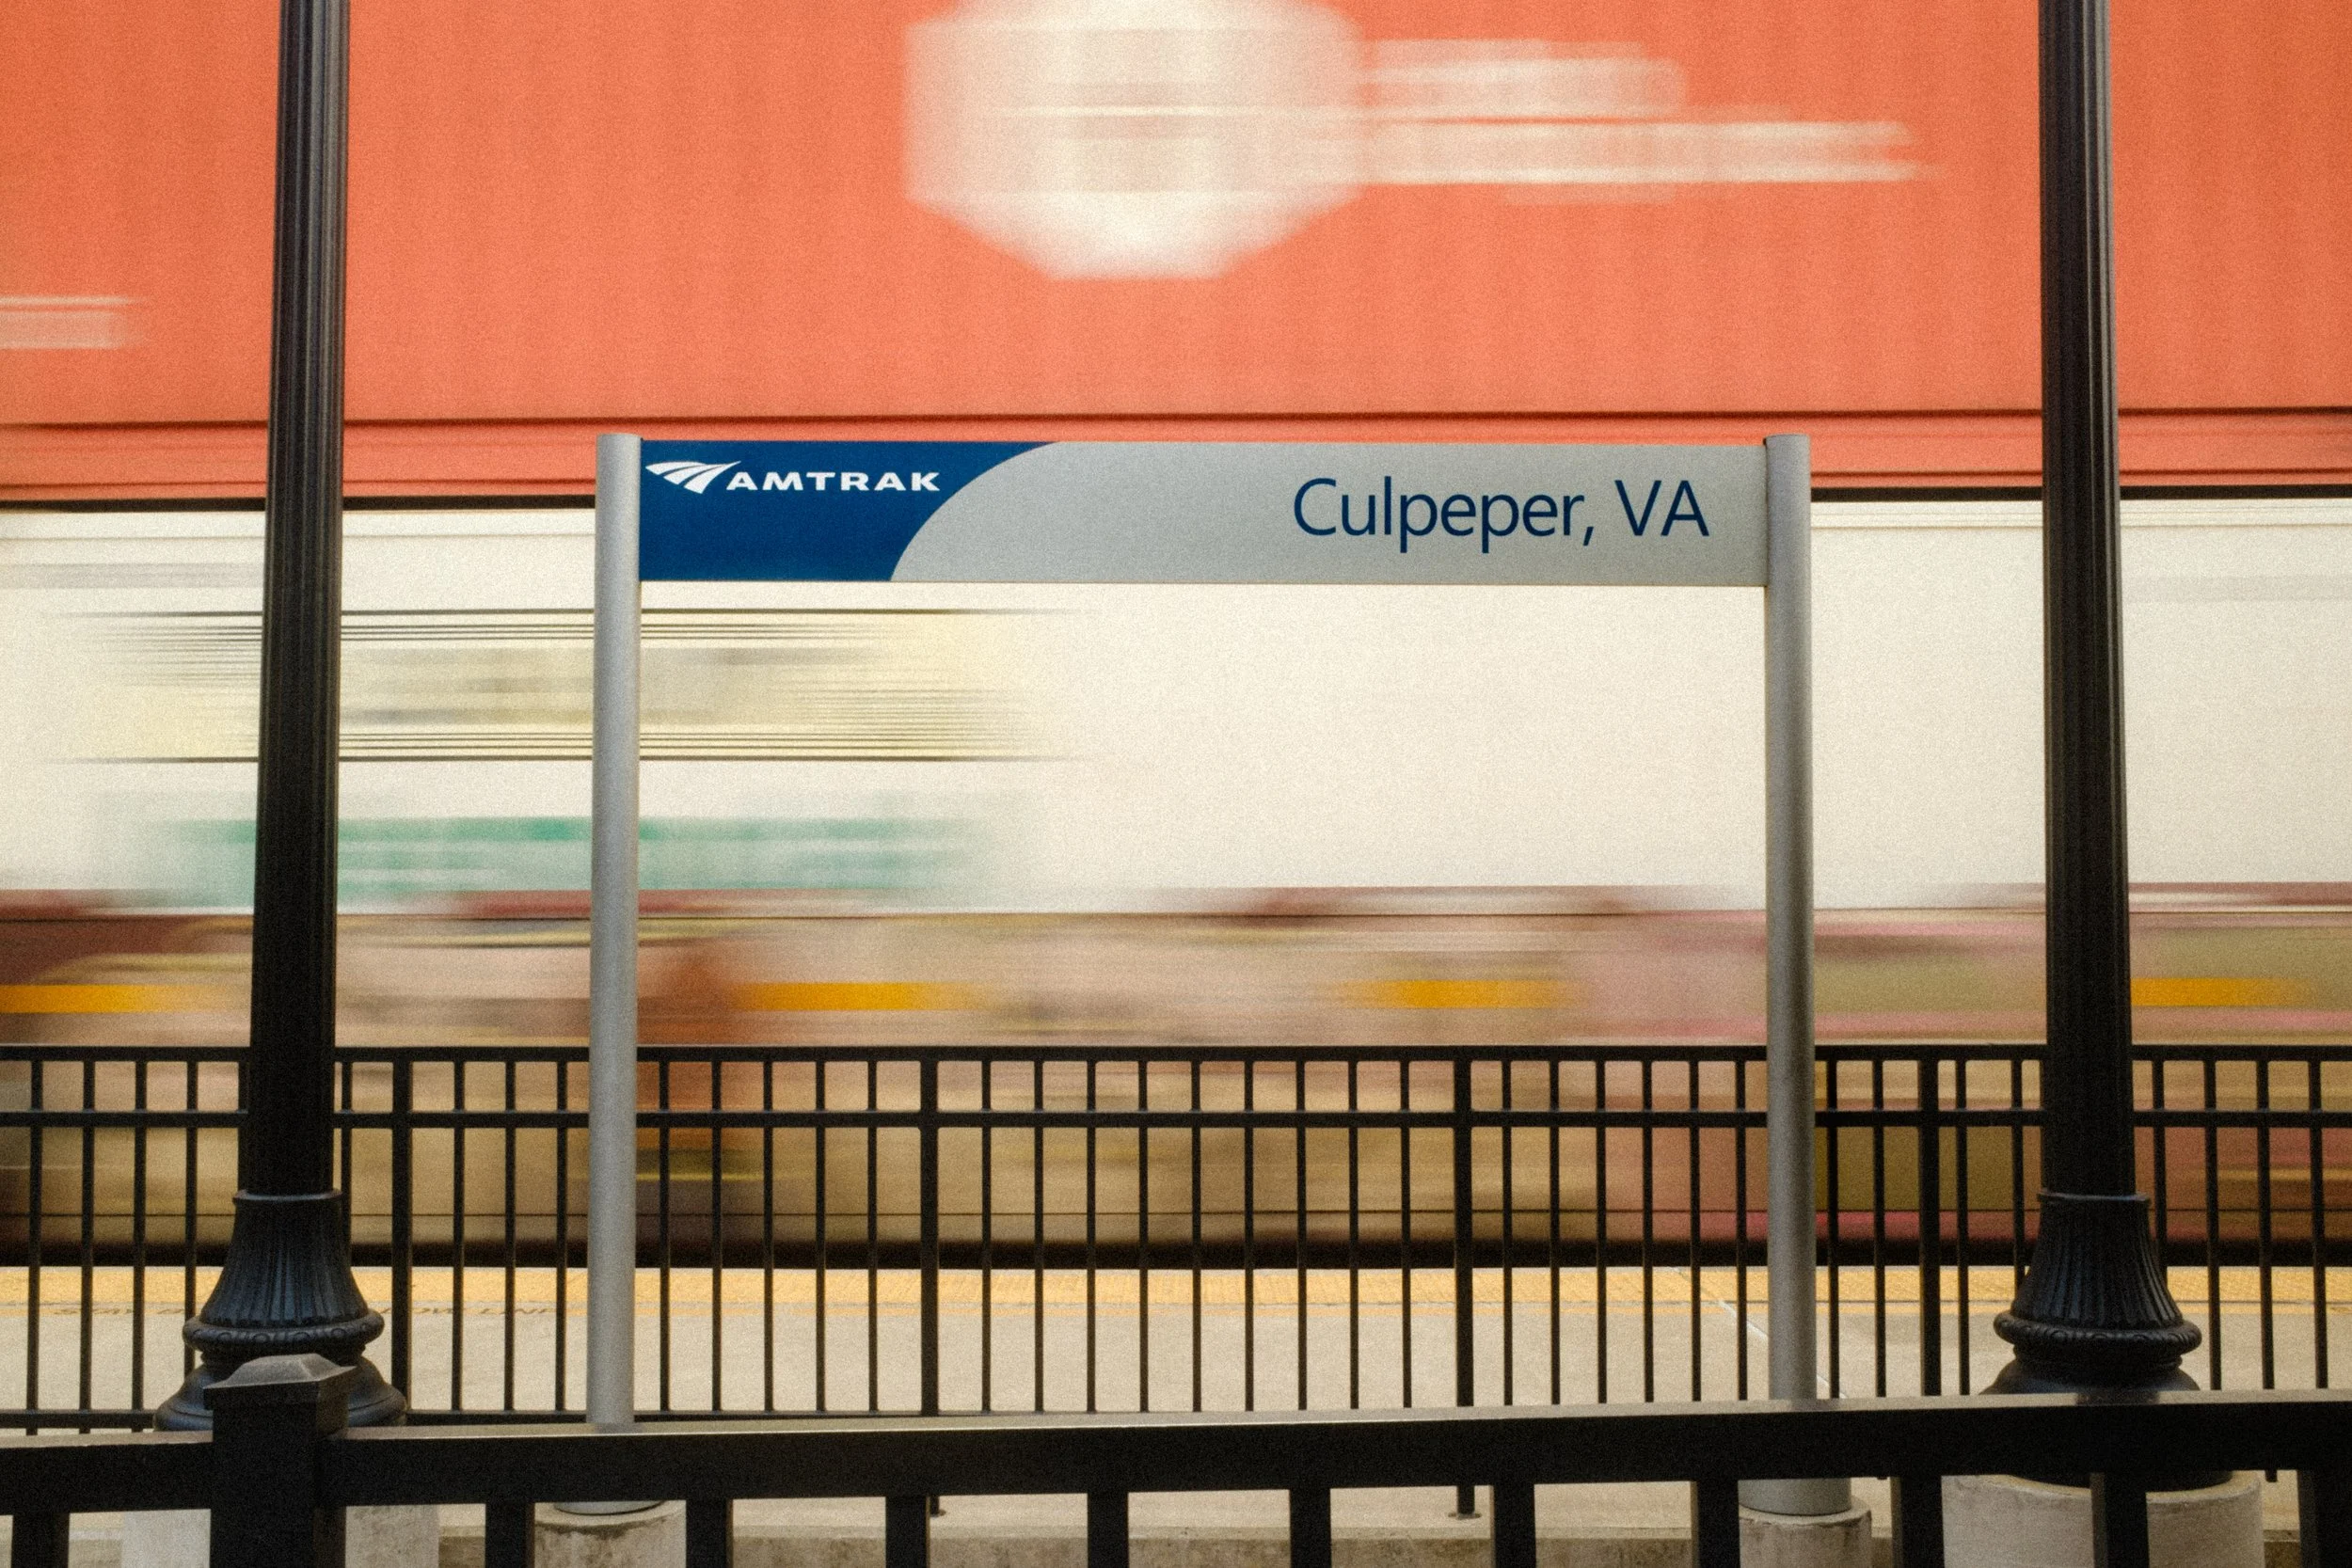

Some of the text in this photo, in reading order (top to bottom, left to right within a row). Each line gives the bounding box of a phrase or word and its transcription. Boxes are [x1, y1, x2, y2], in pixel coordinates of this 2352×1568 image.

[726, 471, 940, 492] AMTRAK
[1293, 476, 1709, 553] Culpeper, VA
